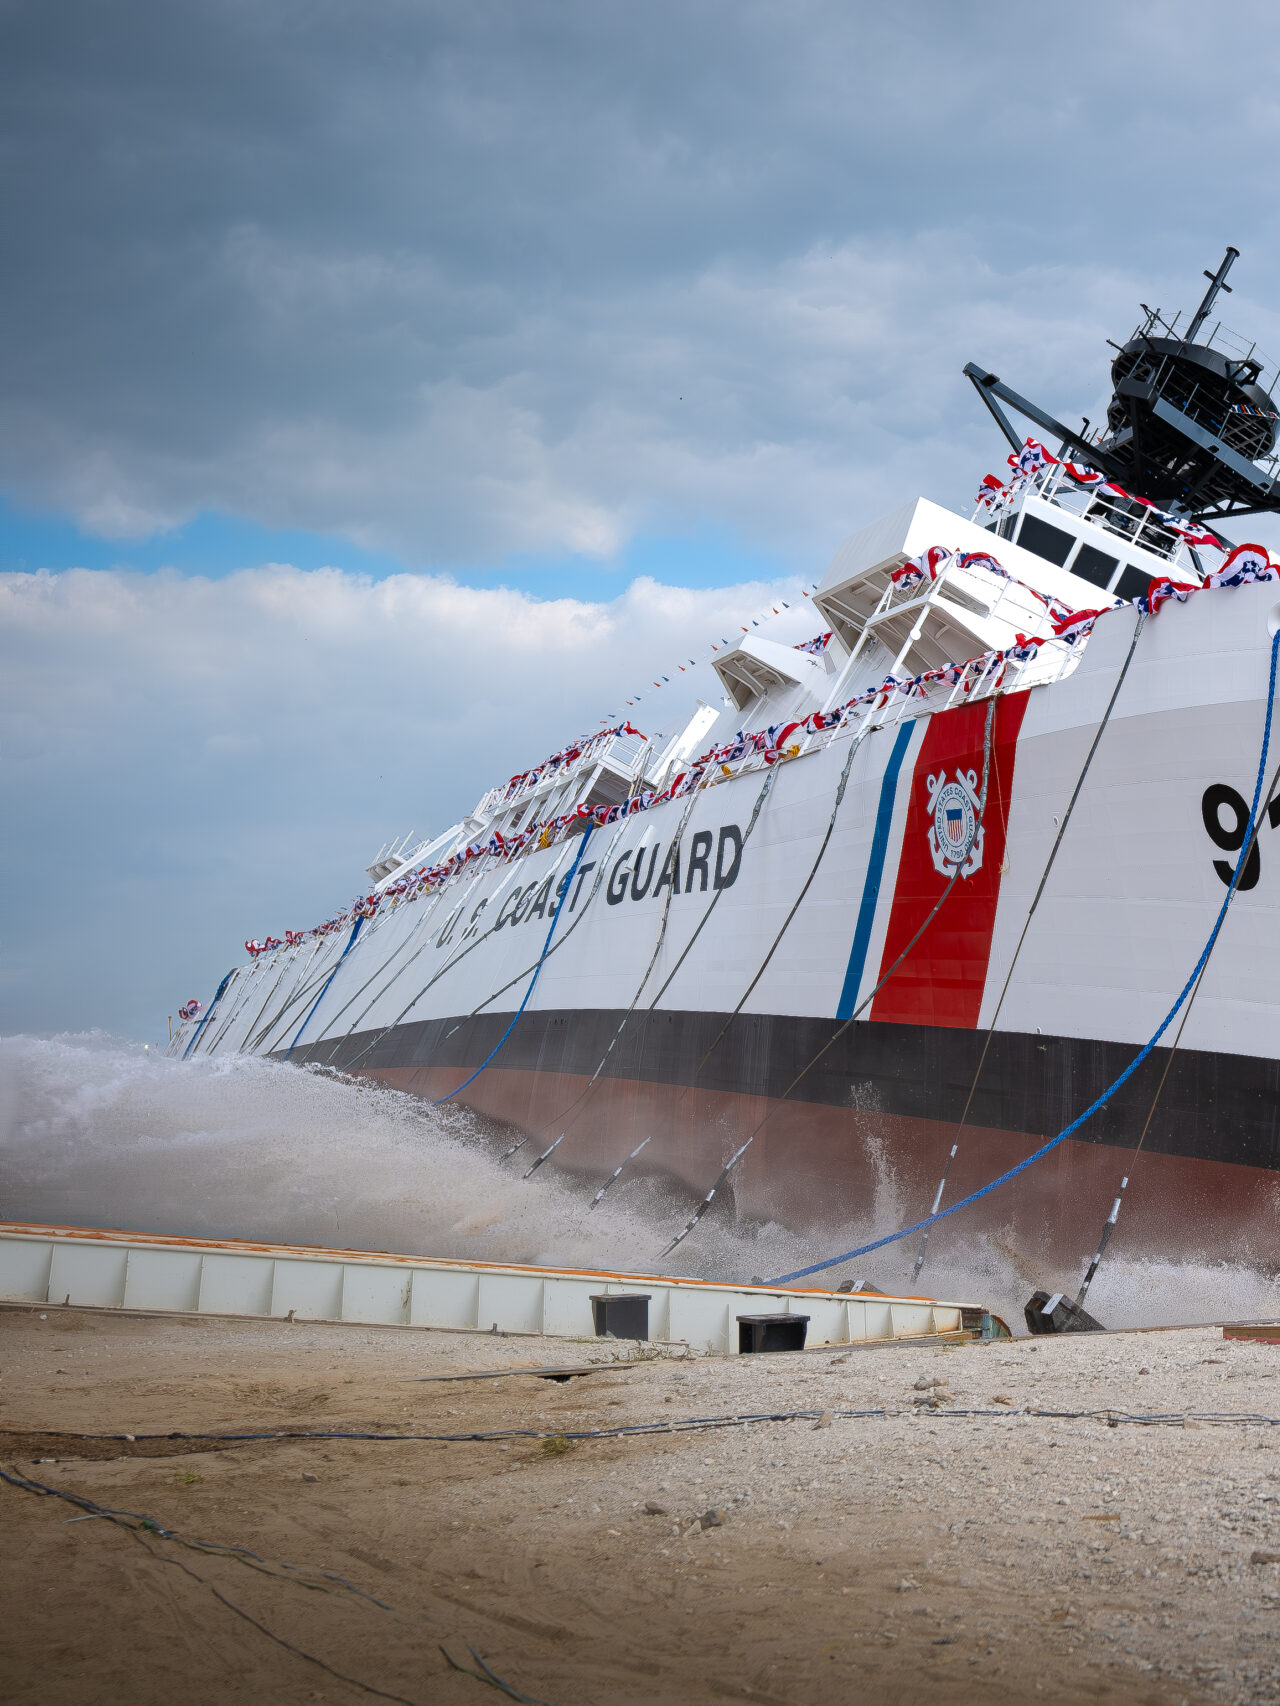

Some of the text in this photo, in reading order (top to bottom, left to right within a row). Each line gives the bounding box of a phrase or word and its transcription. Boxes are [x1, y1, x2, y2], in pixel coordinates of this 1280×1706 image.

[937, 787, 953, 813] STATES
[954, 787, 971, 812] COAST
[494, 861, 597, 931] COAST
[606, 824, 743, 906] GUARD
